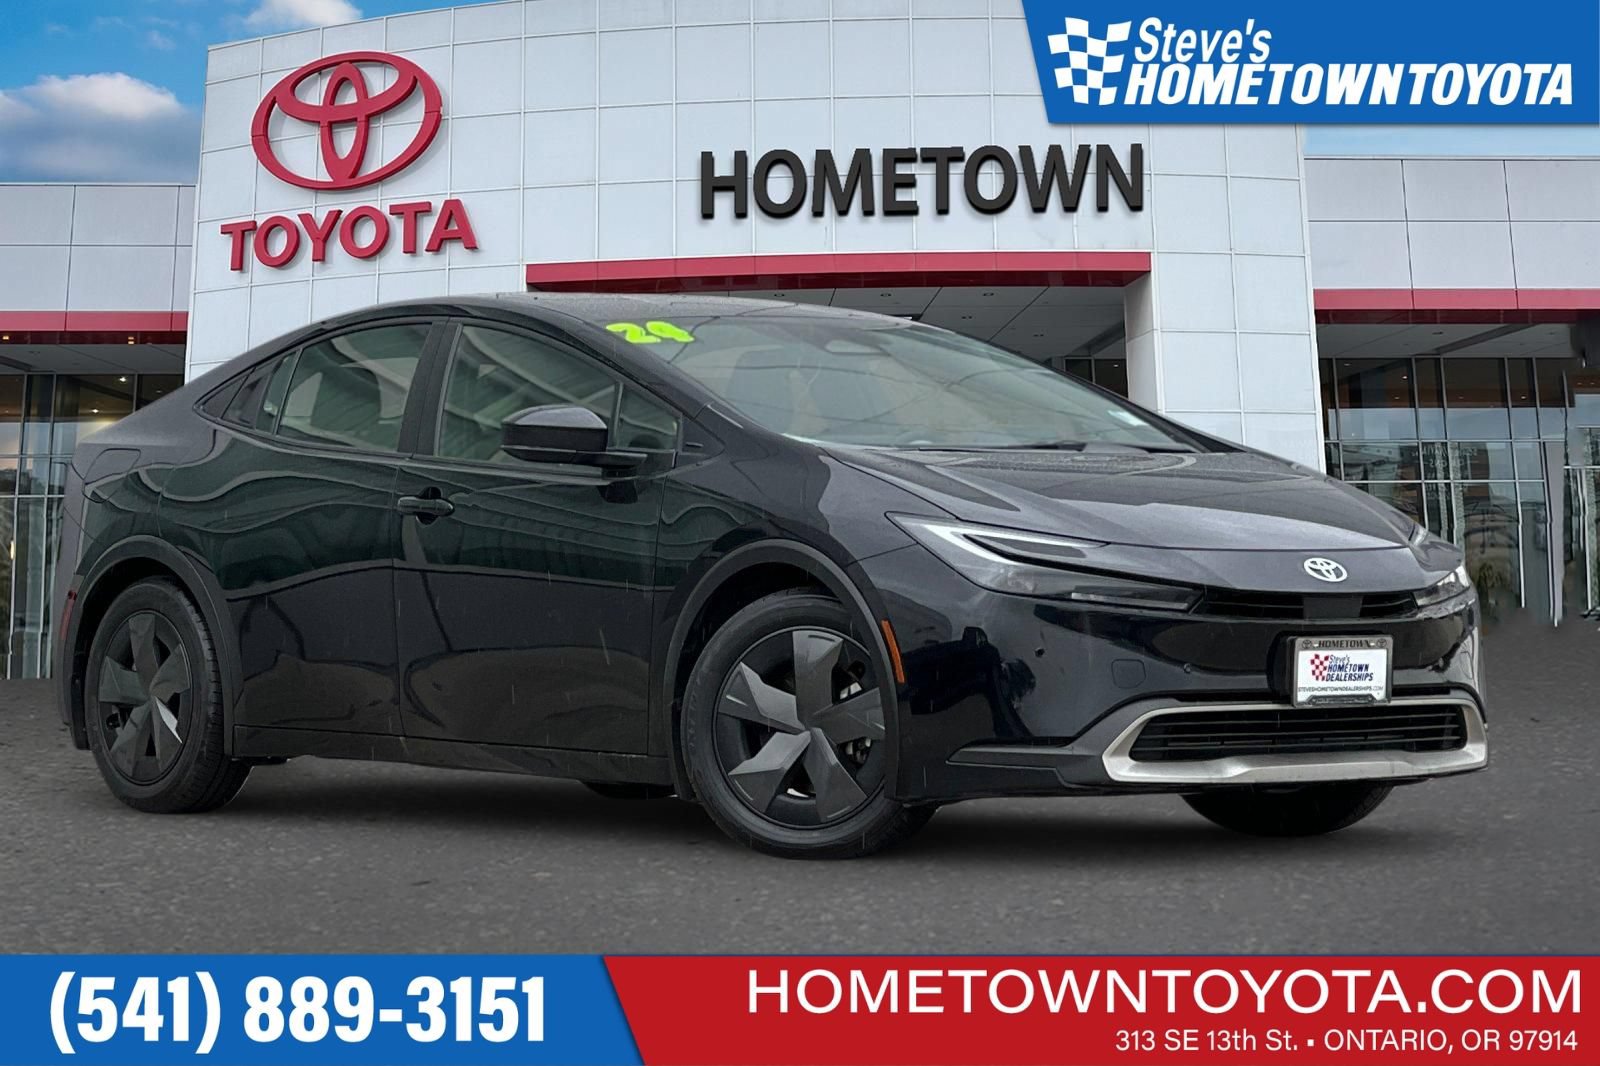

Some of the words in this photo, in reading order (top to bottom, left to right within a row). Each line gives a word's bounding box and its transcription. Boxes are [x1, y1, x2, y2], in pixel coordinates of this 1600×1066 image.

[700, 143, 1146, 220] HOMETOWN
[221, 198, 478, 271] TOYOTA
[1329, 654, 1350, 664] Steve's
[1327, 663, 1370, 672] HOMETOWN
[1326, 673, 1373, 682] DEALERSHIPS
